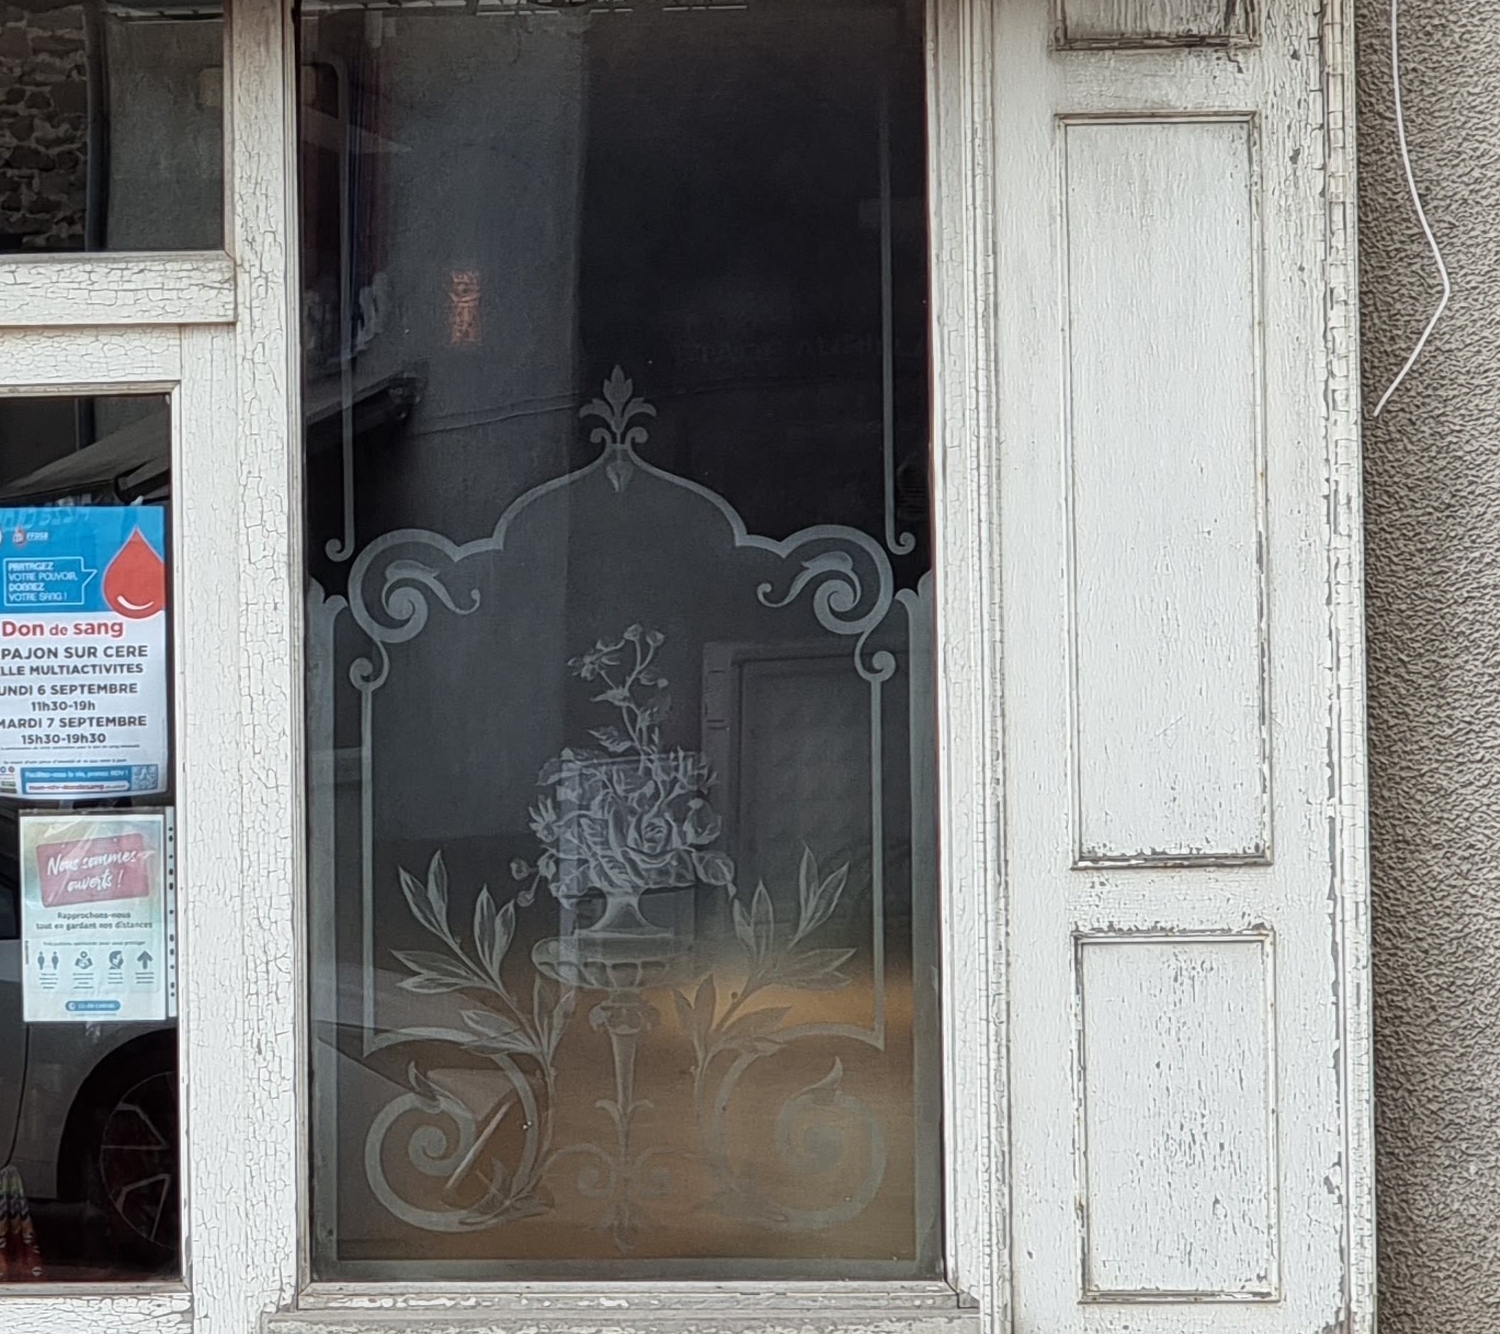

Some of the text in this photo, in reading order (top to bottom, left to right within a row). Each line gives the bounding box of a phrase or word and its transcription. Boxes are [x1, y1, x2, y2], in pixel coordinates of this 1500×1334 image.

[8, 572, 36, 581] VOTRE
[8, 592, 36, 602] VOTRE
[2, 621, 124, 638] Don de sang
[64, 646, 98, 659] SUR
[103, 645, 148, 658] CERE
[29, 663, 143, 676] MULTIACTIVITES
[37, 685, 46, 696] 6
[51, 683, 138, 695] SEPTEMBRE
[31, 701, 96, 712] 11h30-19h
[46, 717, 55, 728] 7
[59, 715, 147, 728] SEPTEMBRE
[21, 733, 106, 745] 15h30-19h30
[46, 850, 138, 876] Nous sommes
[67, 870, 113, 892] ouverts
